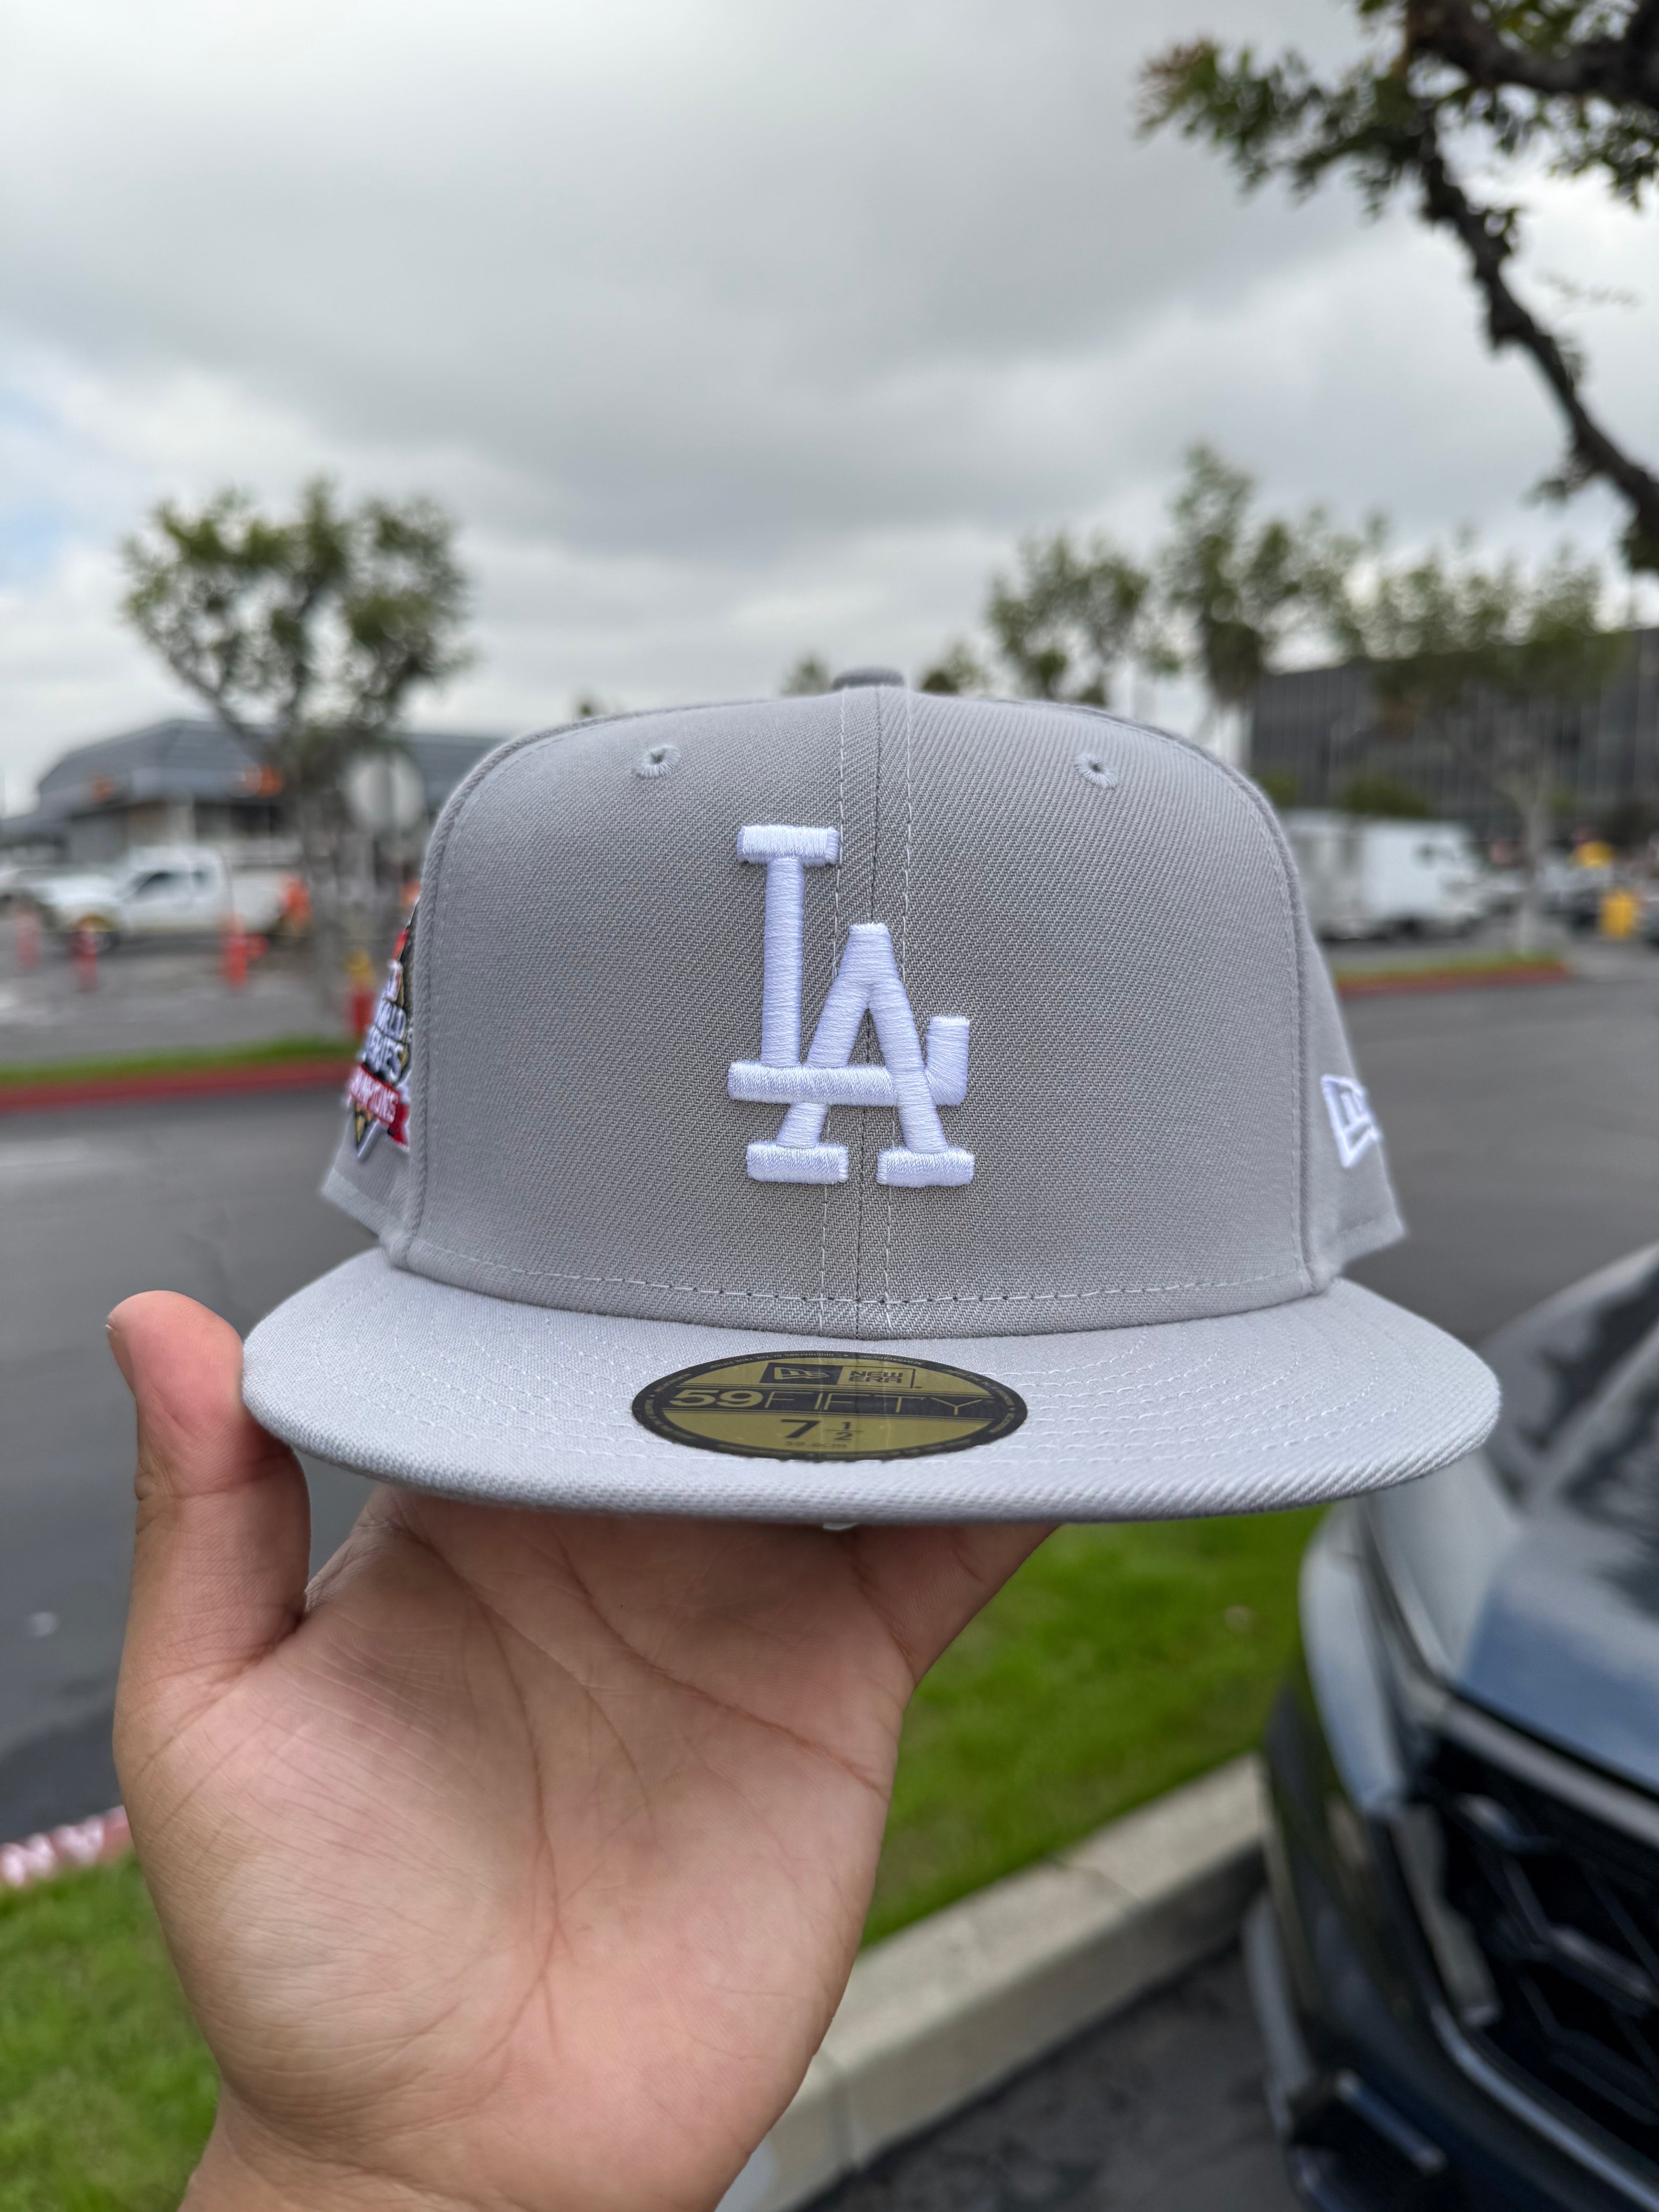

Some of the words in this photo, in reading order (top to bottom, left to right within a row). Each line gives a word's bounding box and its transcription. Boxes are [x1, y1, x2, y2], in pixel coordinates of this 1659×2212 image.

[728, 824, 975, 1187] LA
[669, 1389, 982, 1416] 59FIFTY
[781, 1419, 821, 1438] 7
